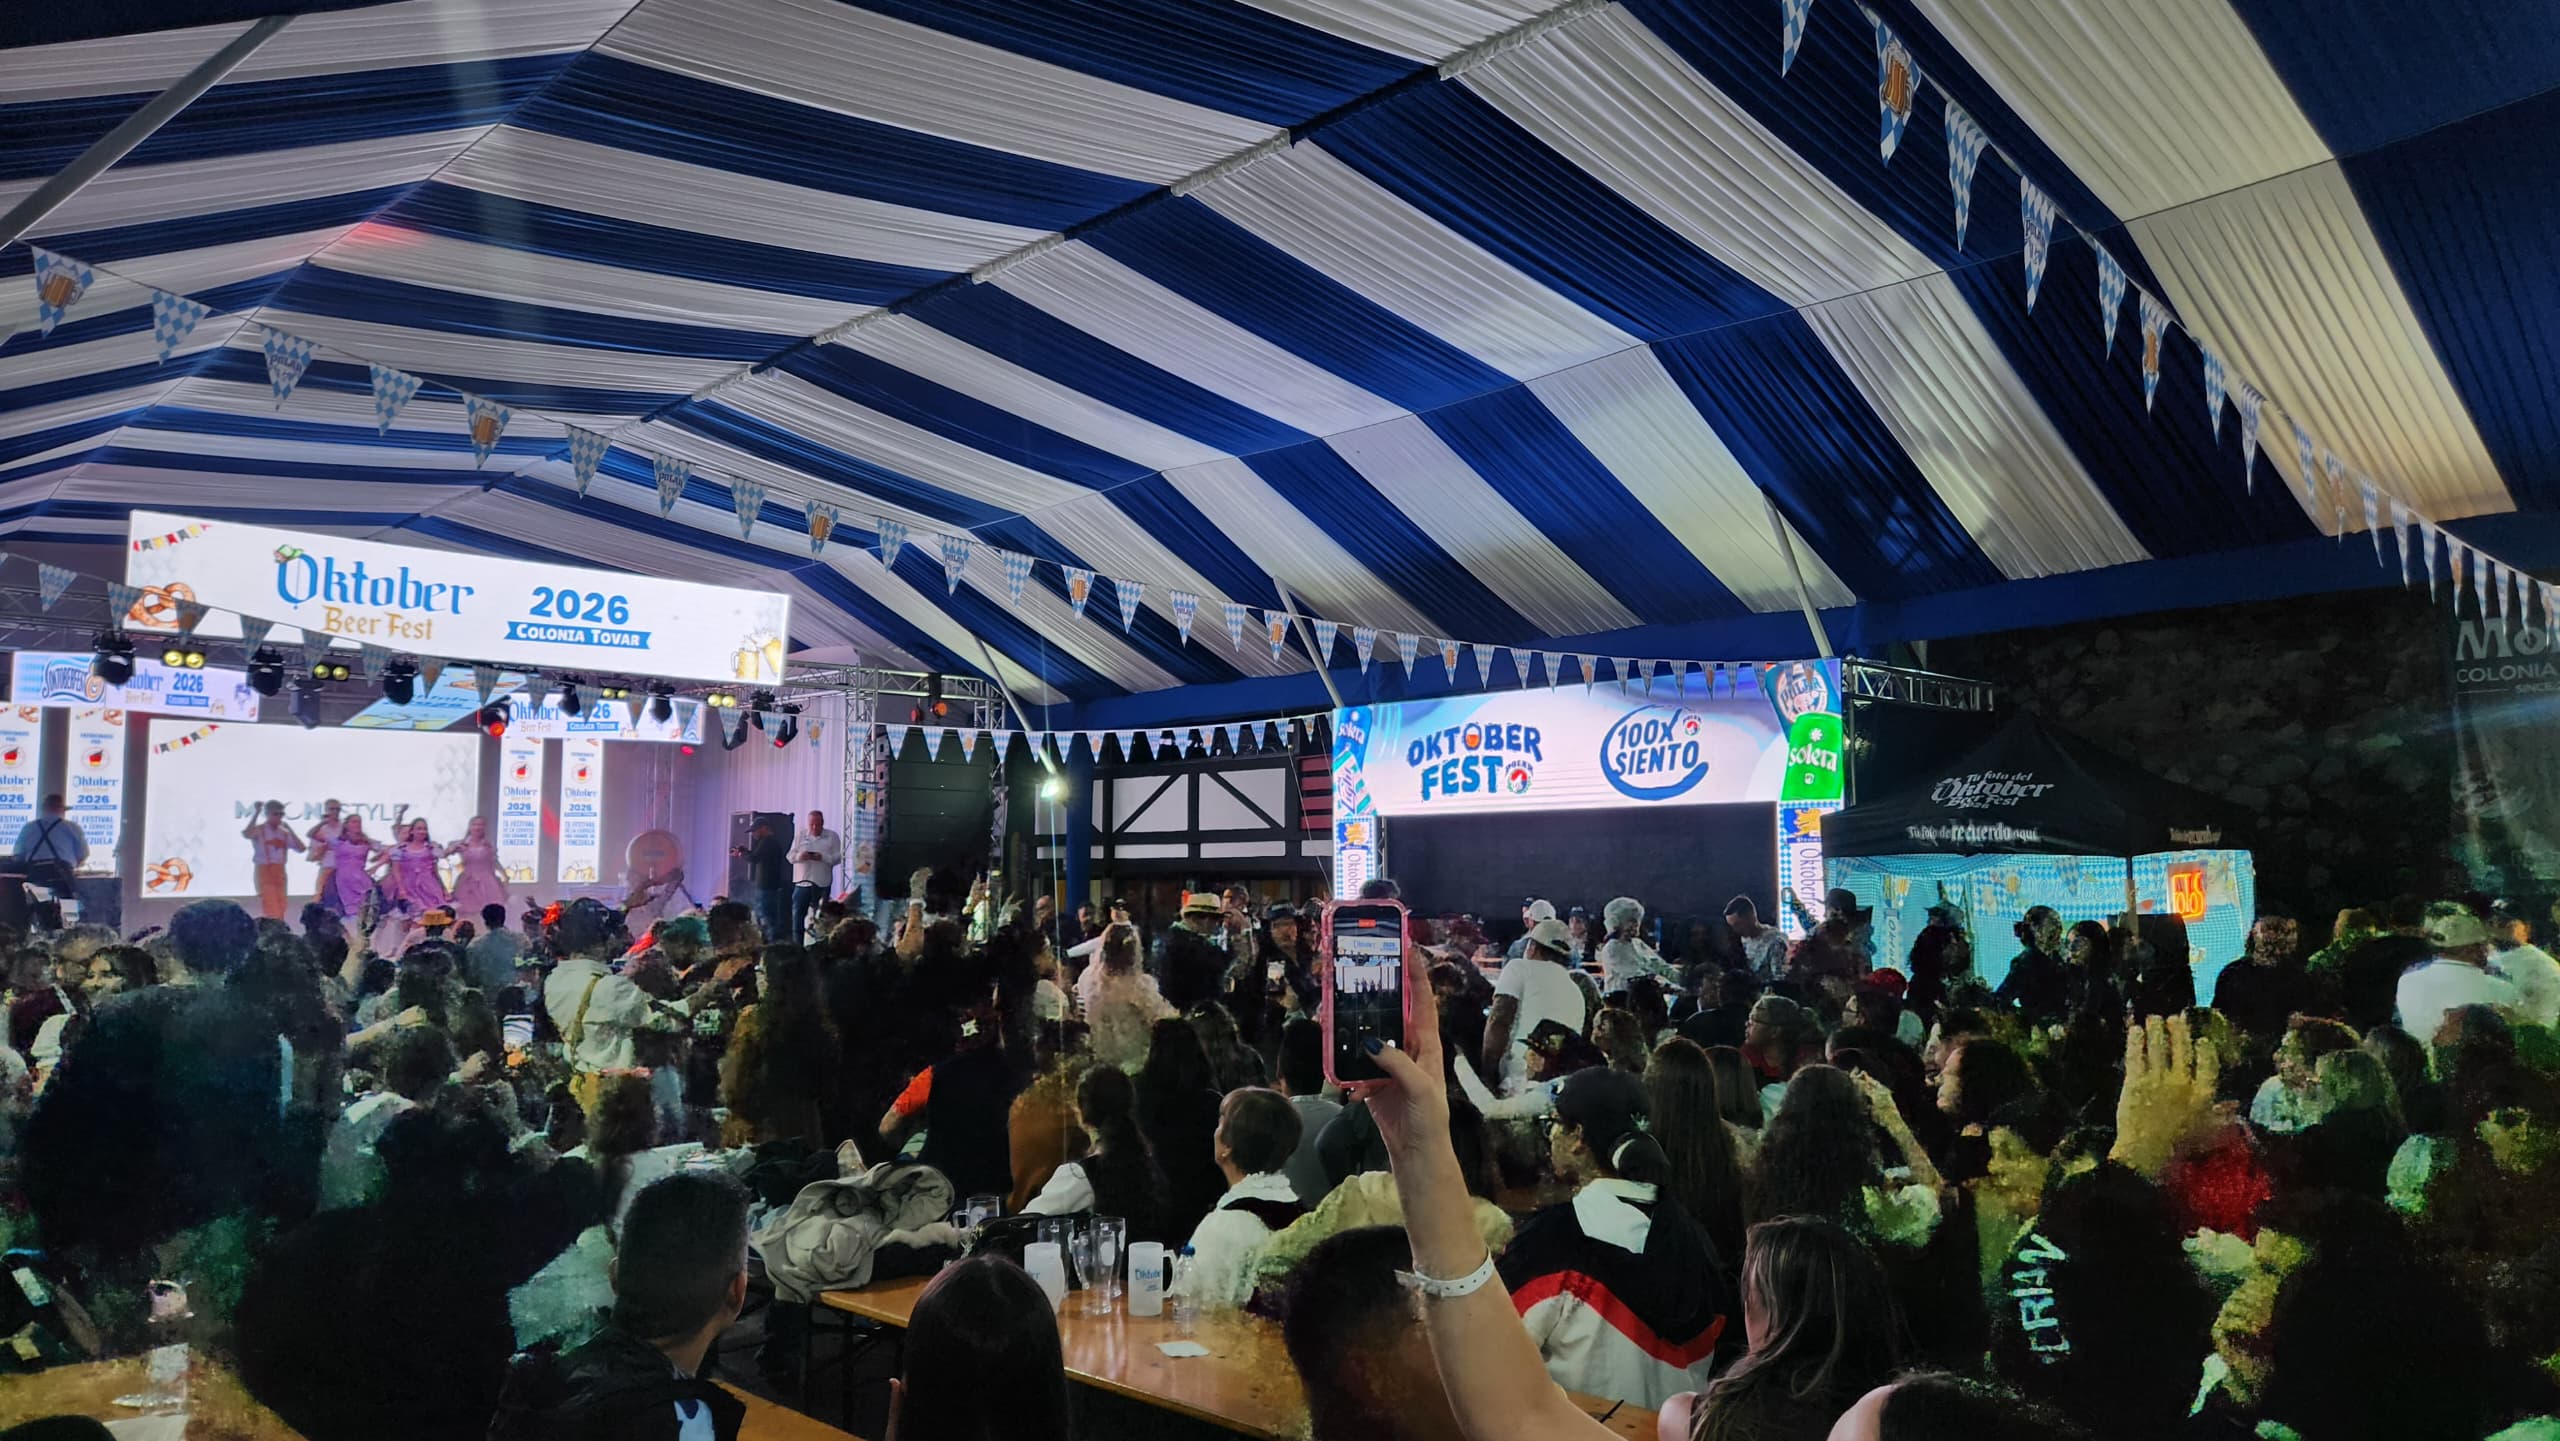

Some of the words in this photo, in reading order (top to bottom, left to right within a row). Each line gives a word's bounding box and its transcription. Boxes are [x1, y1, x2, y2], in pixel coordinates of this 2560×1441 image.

[277, 552, 475, 615] Oktober
[529, 586, 630, 625] 2026
[322, 604, 381, 634] Beer
[384, 611, 433, 640] Fest
[516, 623, 585, 642] COLONIA
[591, 629, 640, 646] TOVAR
[2456, 617, 2560, 660] Mo
[173, 671, 204, 692] 2026
[2456, 662, 2559, 683] COLONIA
[1407, 722, 1543, 768] OKTOBER
[1615, 740, 1700, 776] SIENTO
[1788, 744, 1837, 772] solera
[1421, 755, 1504, 801] FEST
[1931, 777, 2054, 803] Oktober
[2011, 772, 2033, 781] del
[0, 794, 24, 803] 026
[77, 795, 110, 804] 2026
[1951, 821, 2012, 842] recuerdo
